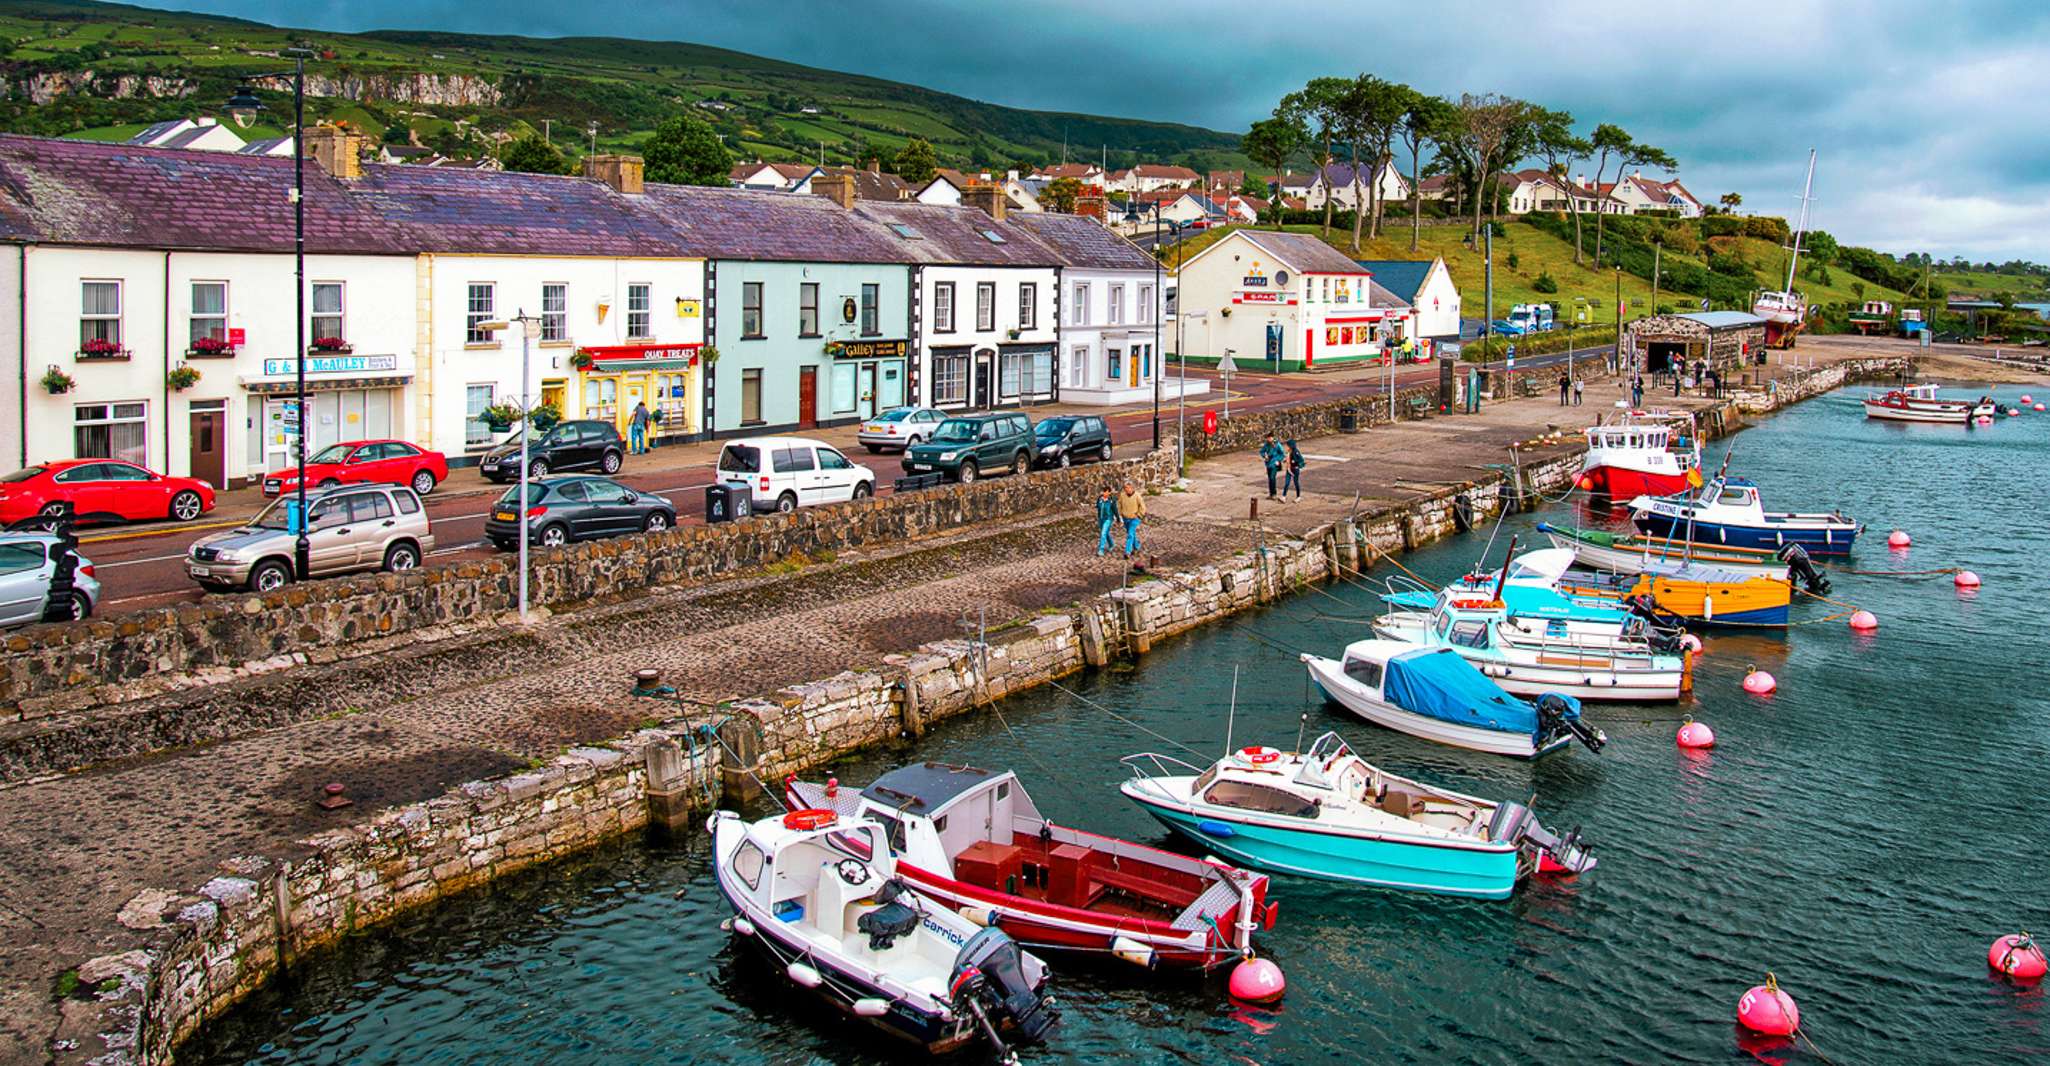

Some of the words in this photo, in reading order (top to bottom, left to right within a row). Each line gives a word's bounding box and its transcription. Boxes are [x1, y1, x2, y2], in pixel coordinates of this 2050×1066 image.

[644, 350, 664, 360] QUAY
[667, 347, 695, 359] TREATS
[268, 361, 277, 374] G
[282, 360, 291, 373] &
[312, 357, 366, 371] McAULEY
[1681, 730, 1690, 743] 8
[1259, 967, 1275, 988] 4
[1740, 993, 1757, 1016] 5
